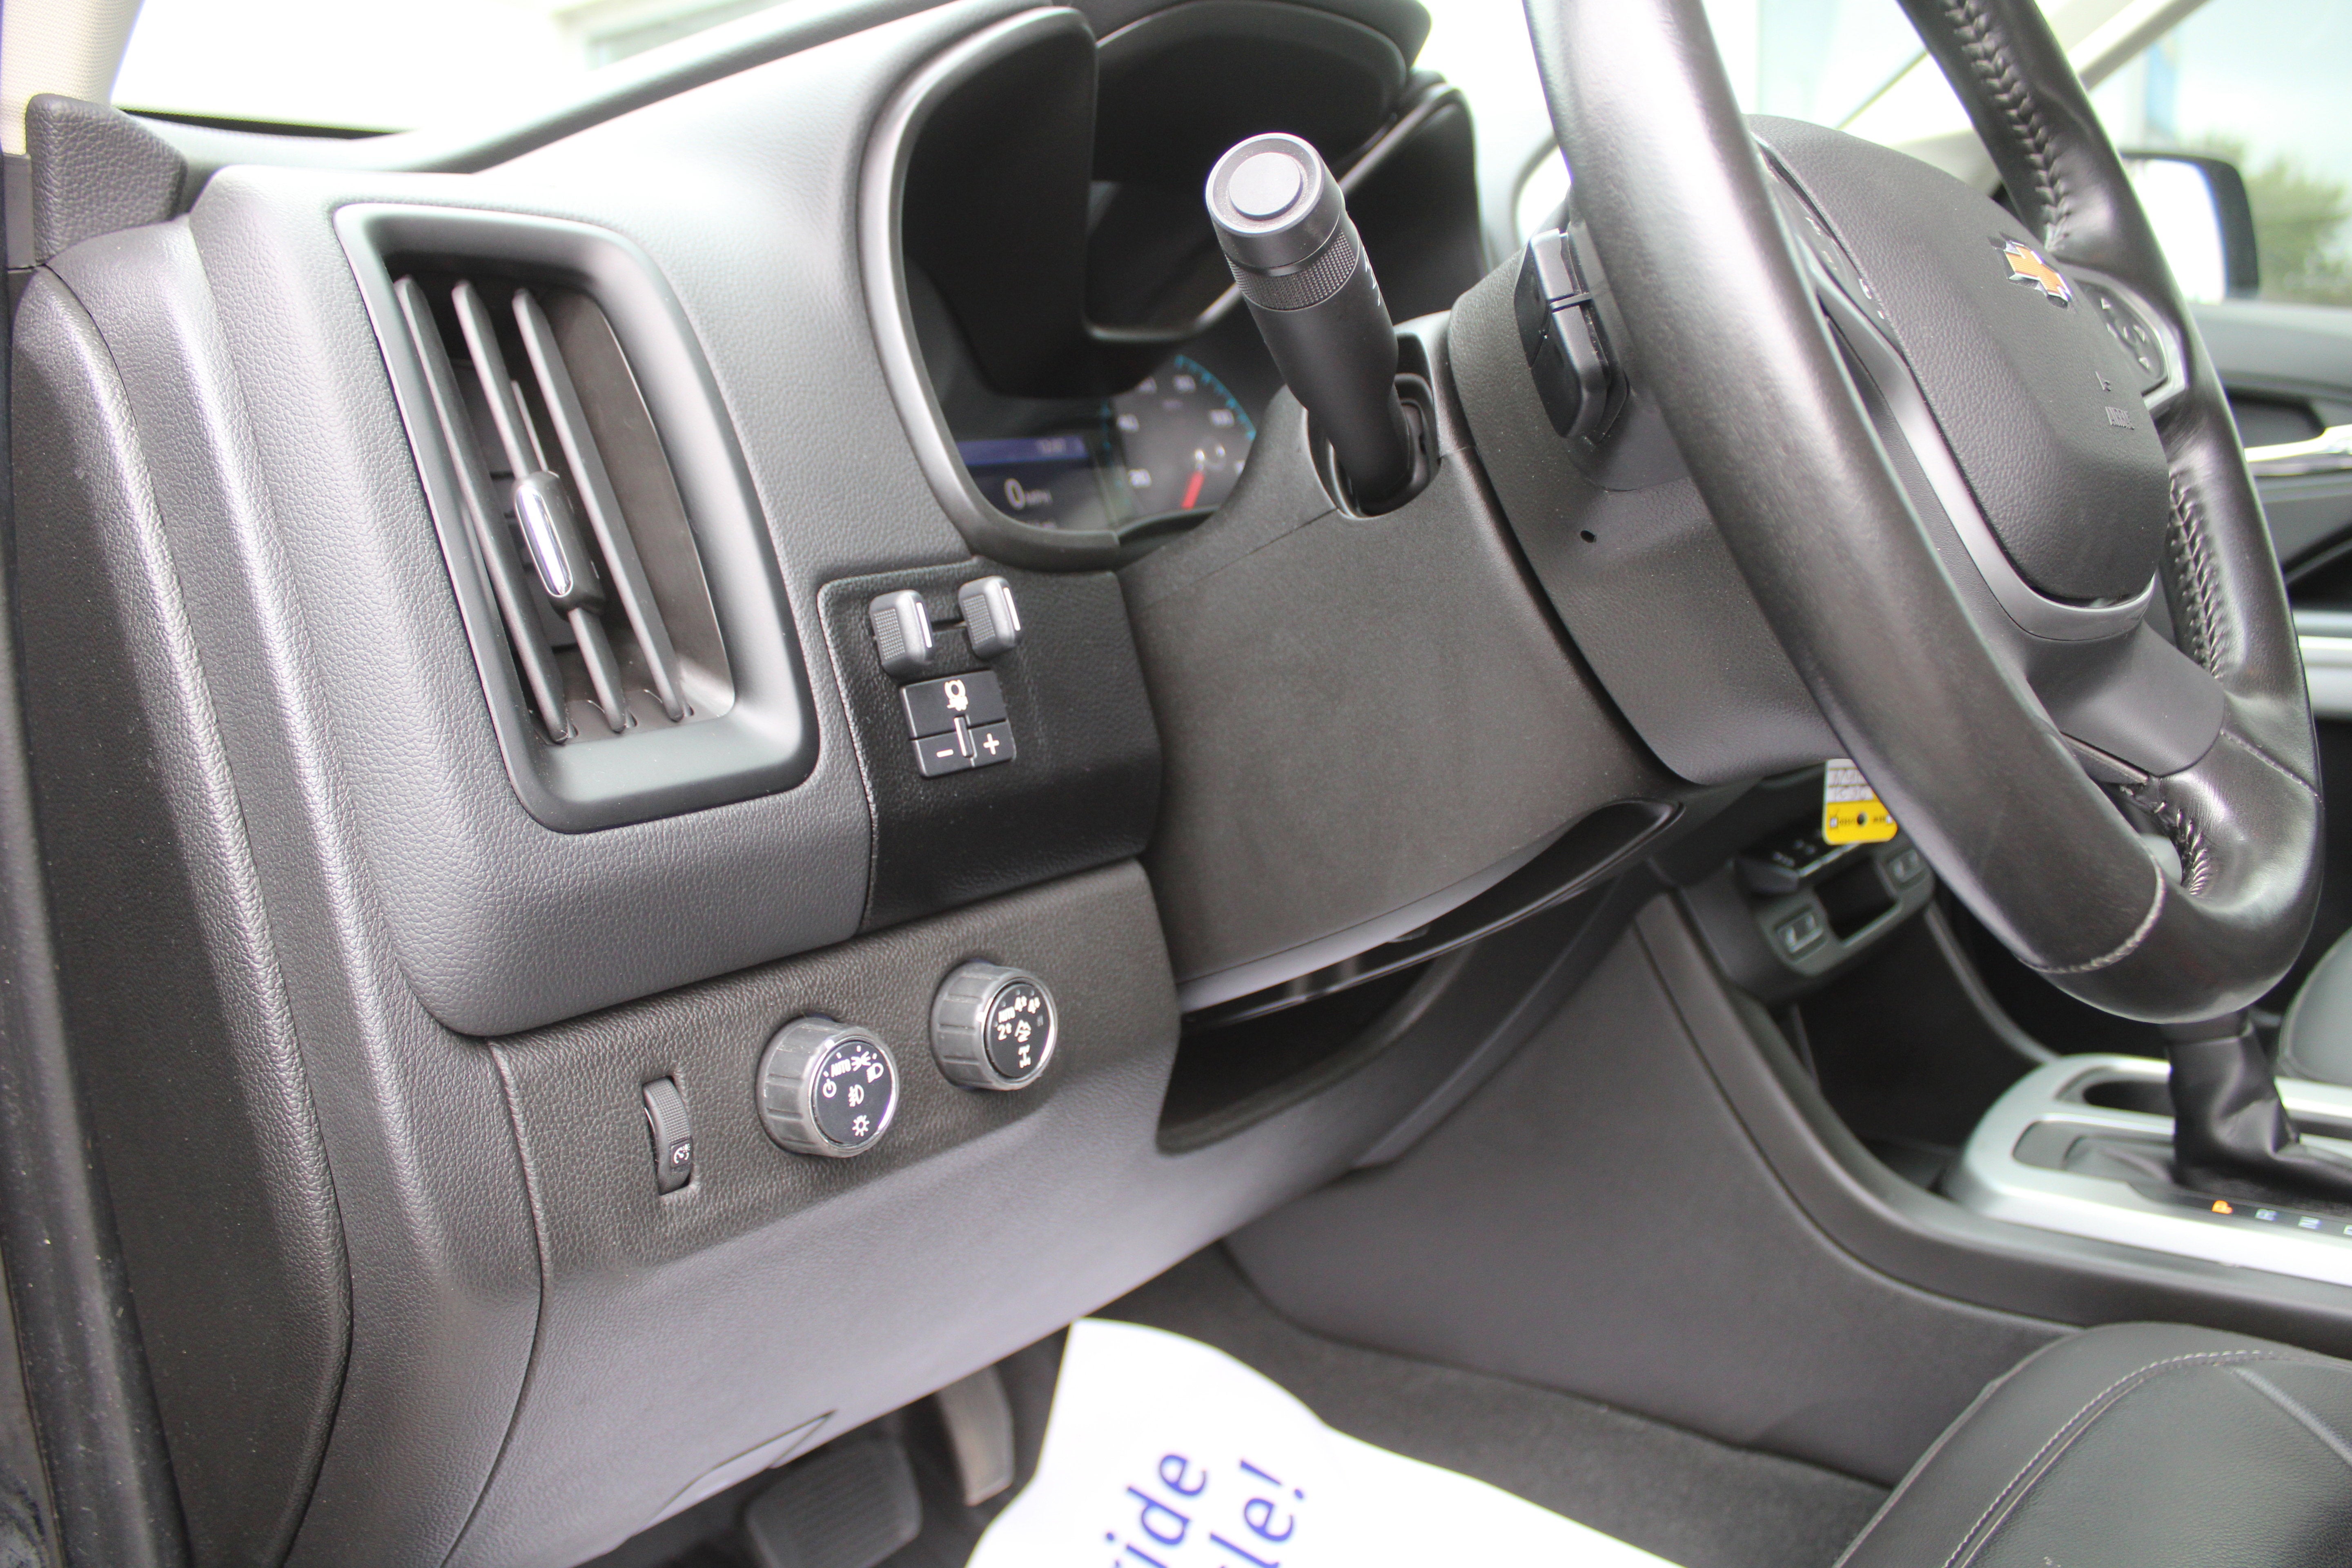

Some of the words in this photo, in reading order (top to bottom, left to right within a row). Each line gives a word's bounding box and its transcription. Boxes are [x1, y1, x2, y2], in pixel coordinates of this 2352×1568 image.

[1004, 478, 1026, 510] 0
[998, 1006, 1016, 1023] AUTO
[831, 1059, 851, 1077] AUTO
[2212, 1200, 2233, 1214] P
[1107, 1454, 1206, 1568] ide
[1209, 1459, 1303, 1568] le!
